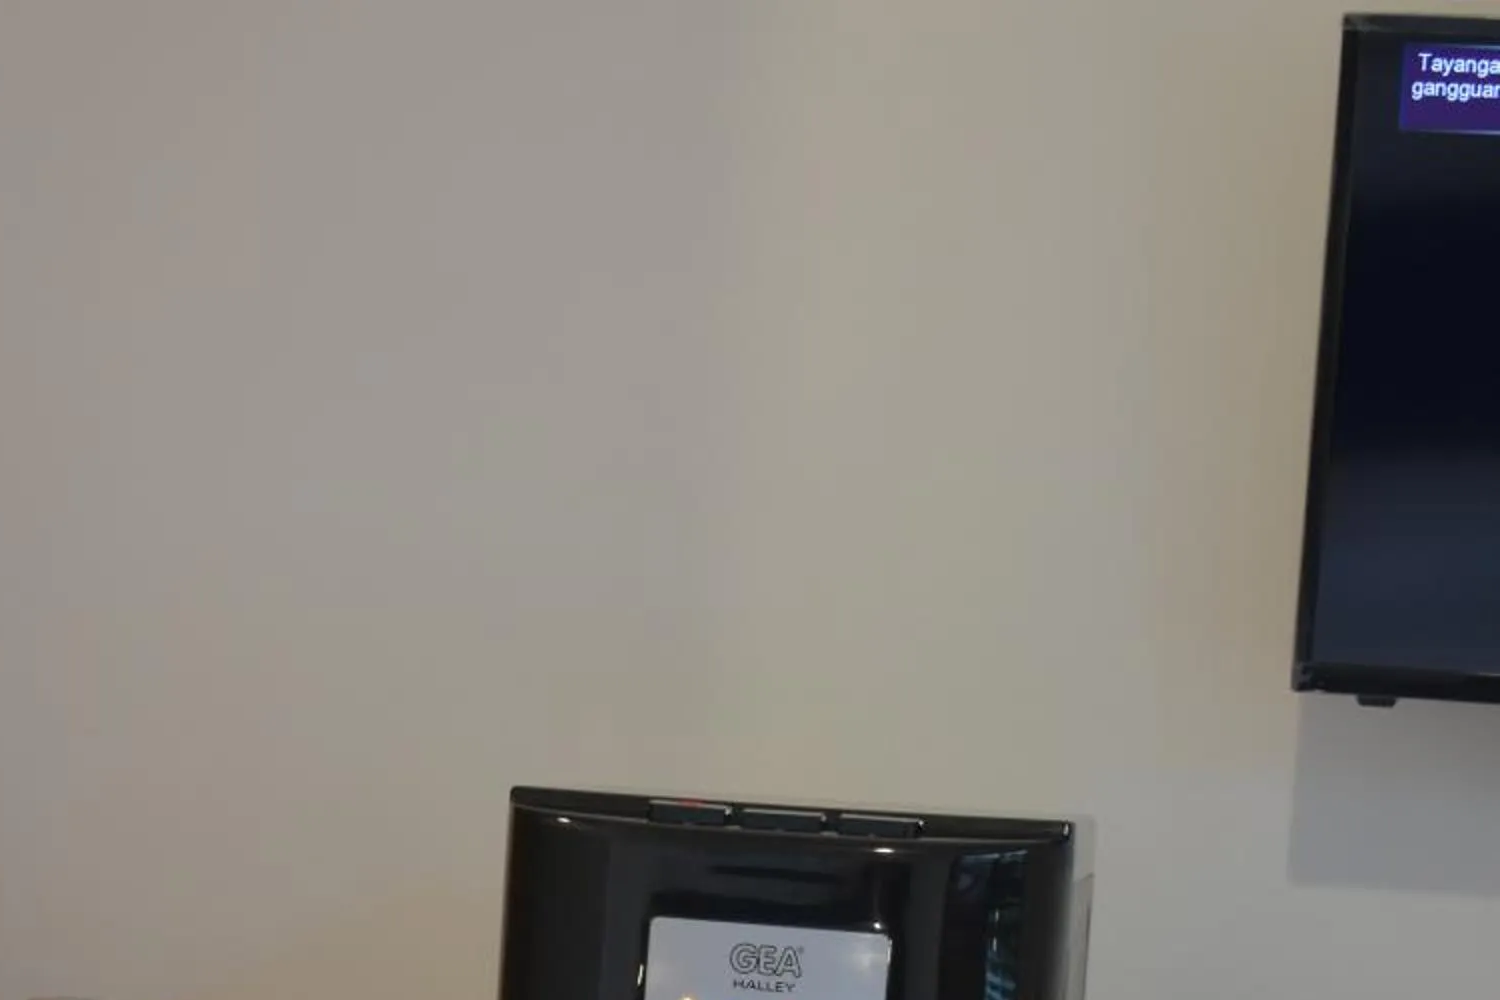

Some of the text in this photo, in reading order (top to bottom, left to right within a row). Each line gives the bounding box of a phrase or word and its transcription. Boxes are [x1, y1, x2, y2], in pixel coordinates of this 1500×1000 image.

[1417, 53, 1500, 78] Tayanga
[729, 943, 802, 978] GEA
[733, 980, 796, 993] HALLEY
